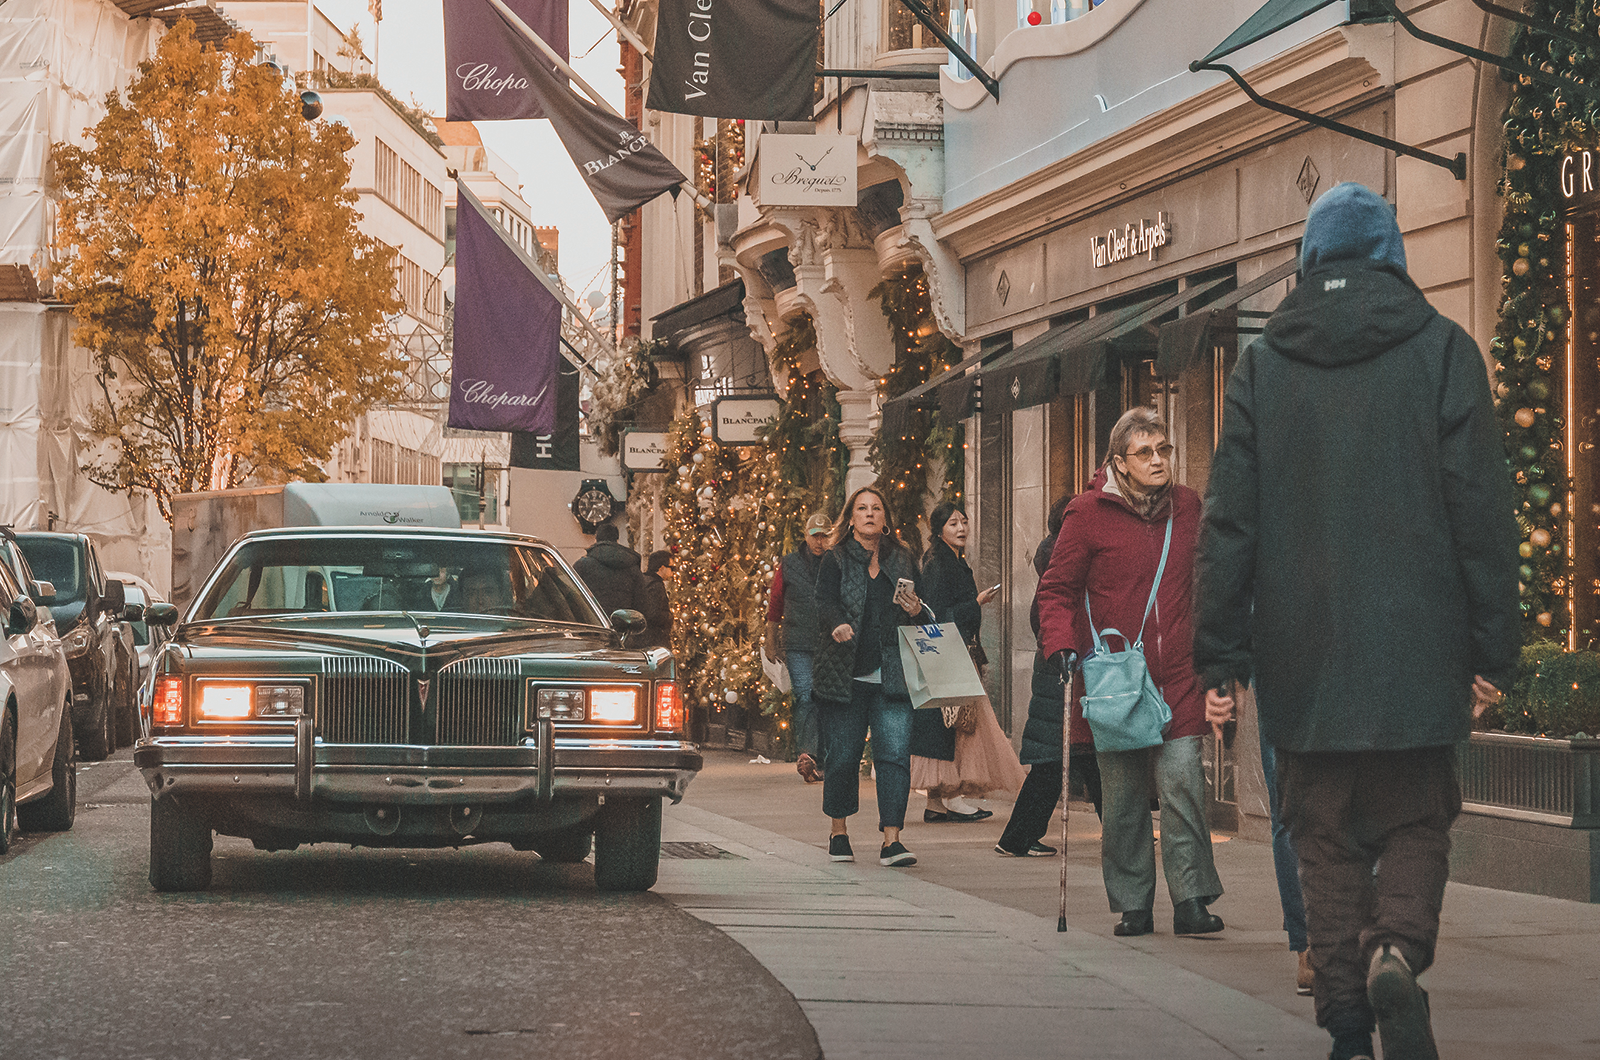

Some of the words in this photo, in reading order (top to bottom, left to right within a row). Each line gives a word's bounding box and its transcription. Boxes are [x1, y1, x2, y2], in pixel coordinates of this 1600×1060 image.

[456, 62, 529, 96] Chopa
[685, 52, 710, 101] Van
[771, 167, 846, 192] Breguet
[1562, 151, 1593, 197] GR
[1090, 236, 1106, 268] Van
[1107, 223, 1130, 263] Cleef
[1130, 229, 1138, 255] &
[1138, 211, 1166, 261] Arpels
[460, 379, 547, 409] Chopard
